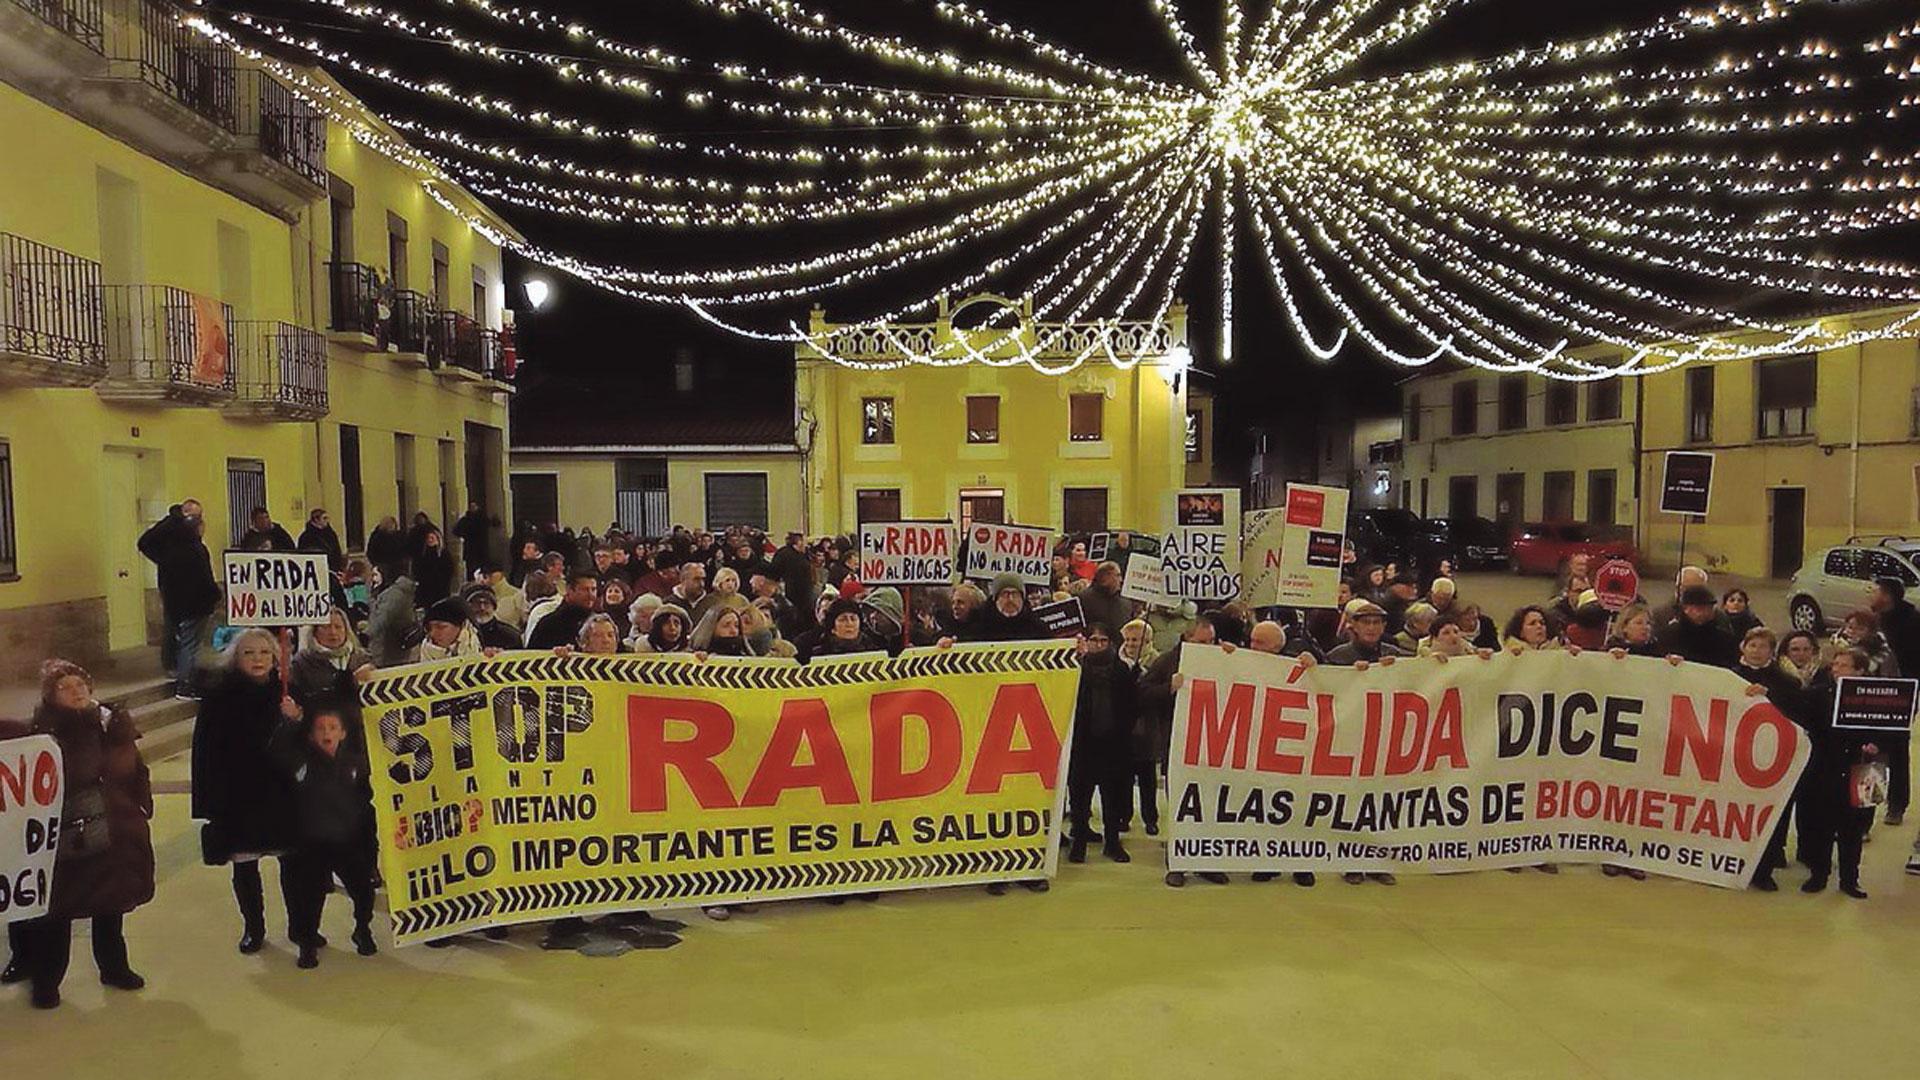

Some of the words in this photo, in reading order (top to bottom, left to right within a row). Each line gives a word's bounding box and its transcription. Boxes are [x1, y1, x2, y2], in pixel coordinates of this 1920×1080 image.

[864, 533, 885, 553] EN
[886, 527, 947, 555] RADA
[995, 529, 1047, 558] RADA
[1163, 528, 1227, 555] AIRE
[229, 562, 251, 584] EN
[255, 558, 319, 590] RADA
[863, 559, 885, 580] NO
[886, 565, 899, 580] AL
[902, 556, 951, 580] BIOGAS
[970, 550, 987, 570] NO
[991, 560, 1002, 572] AL
[1005, 557, 1050, 576] BIOGAS
[1161, 555, 1227, 573] AGUA
[231, 592, 257, 618] NO
[261, 599, 279, 618] AL
[284, 591, 330, 618] BIOGAS
[379, 685, 595, 785] STOP
[1184, 665, 1470, 777] MÉLIDA
[1497, 692, 1643, 763] DICE
[1663, 694, 1798, 789] NO
[627, 682, 1062, 813] RADA
[0, 751, 58, 813] NO
[492, 793, 597, 826] METANO
[1176, 783, 1203, 823] A
[1216, 785, 1294, 826] LAS
[1305, 785, 1470, 832] PLANTAS
[1482, 782, 1526, 825] DE
[512, 825, 775, 873] IMPORTANTE
[789, 823, 838, 852] ES
[852, 821, 900, 848] LA
[1174, 839, 1261, 857] NUESTRA
[1267, 839, 1331, 861] SALUD,
[1337, 842, 1423, 862] NUESTRO
[1427, 842, 1472, 861] AIRE,
[1478, 834, 1553, 857] NUESTRA
[1558, 833, 1634, 857] TIERRA,
[1641, 841, 1671, 861] NO
[1677, 847, 1704, 868] SE
